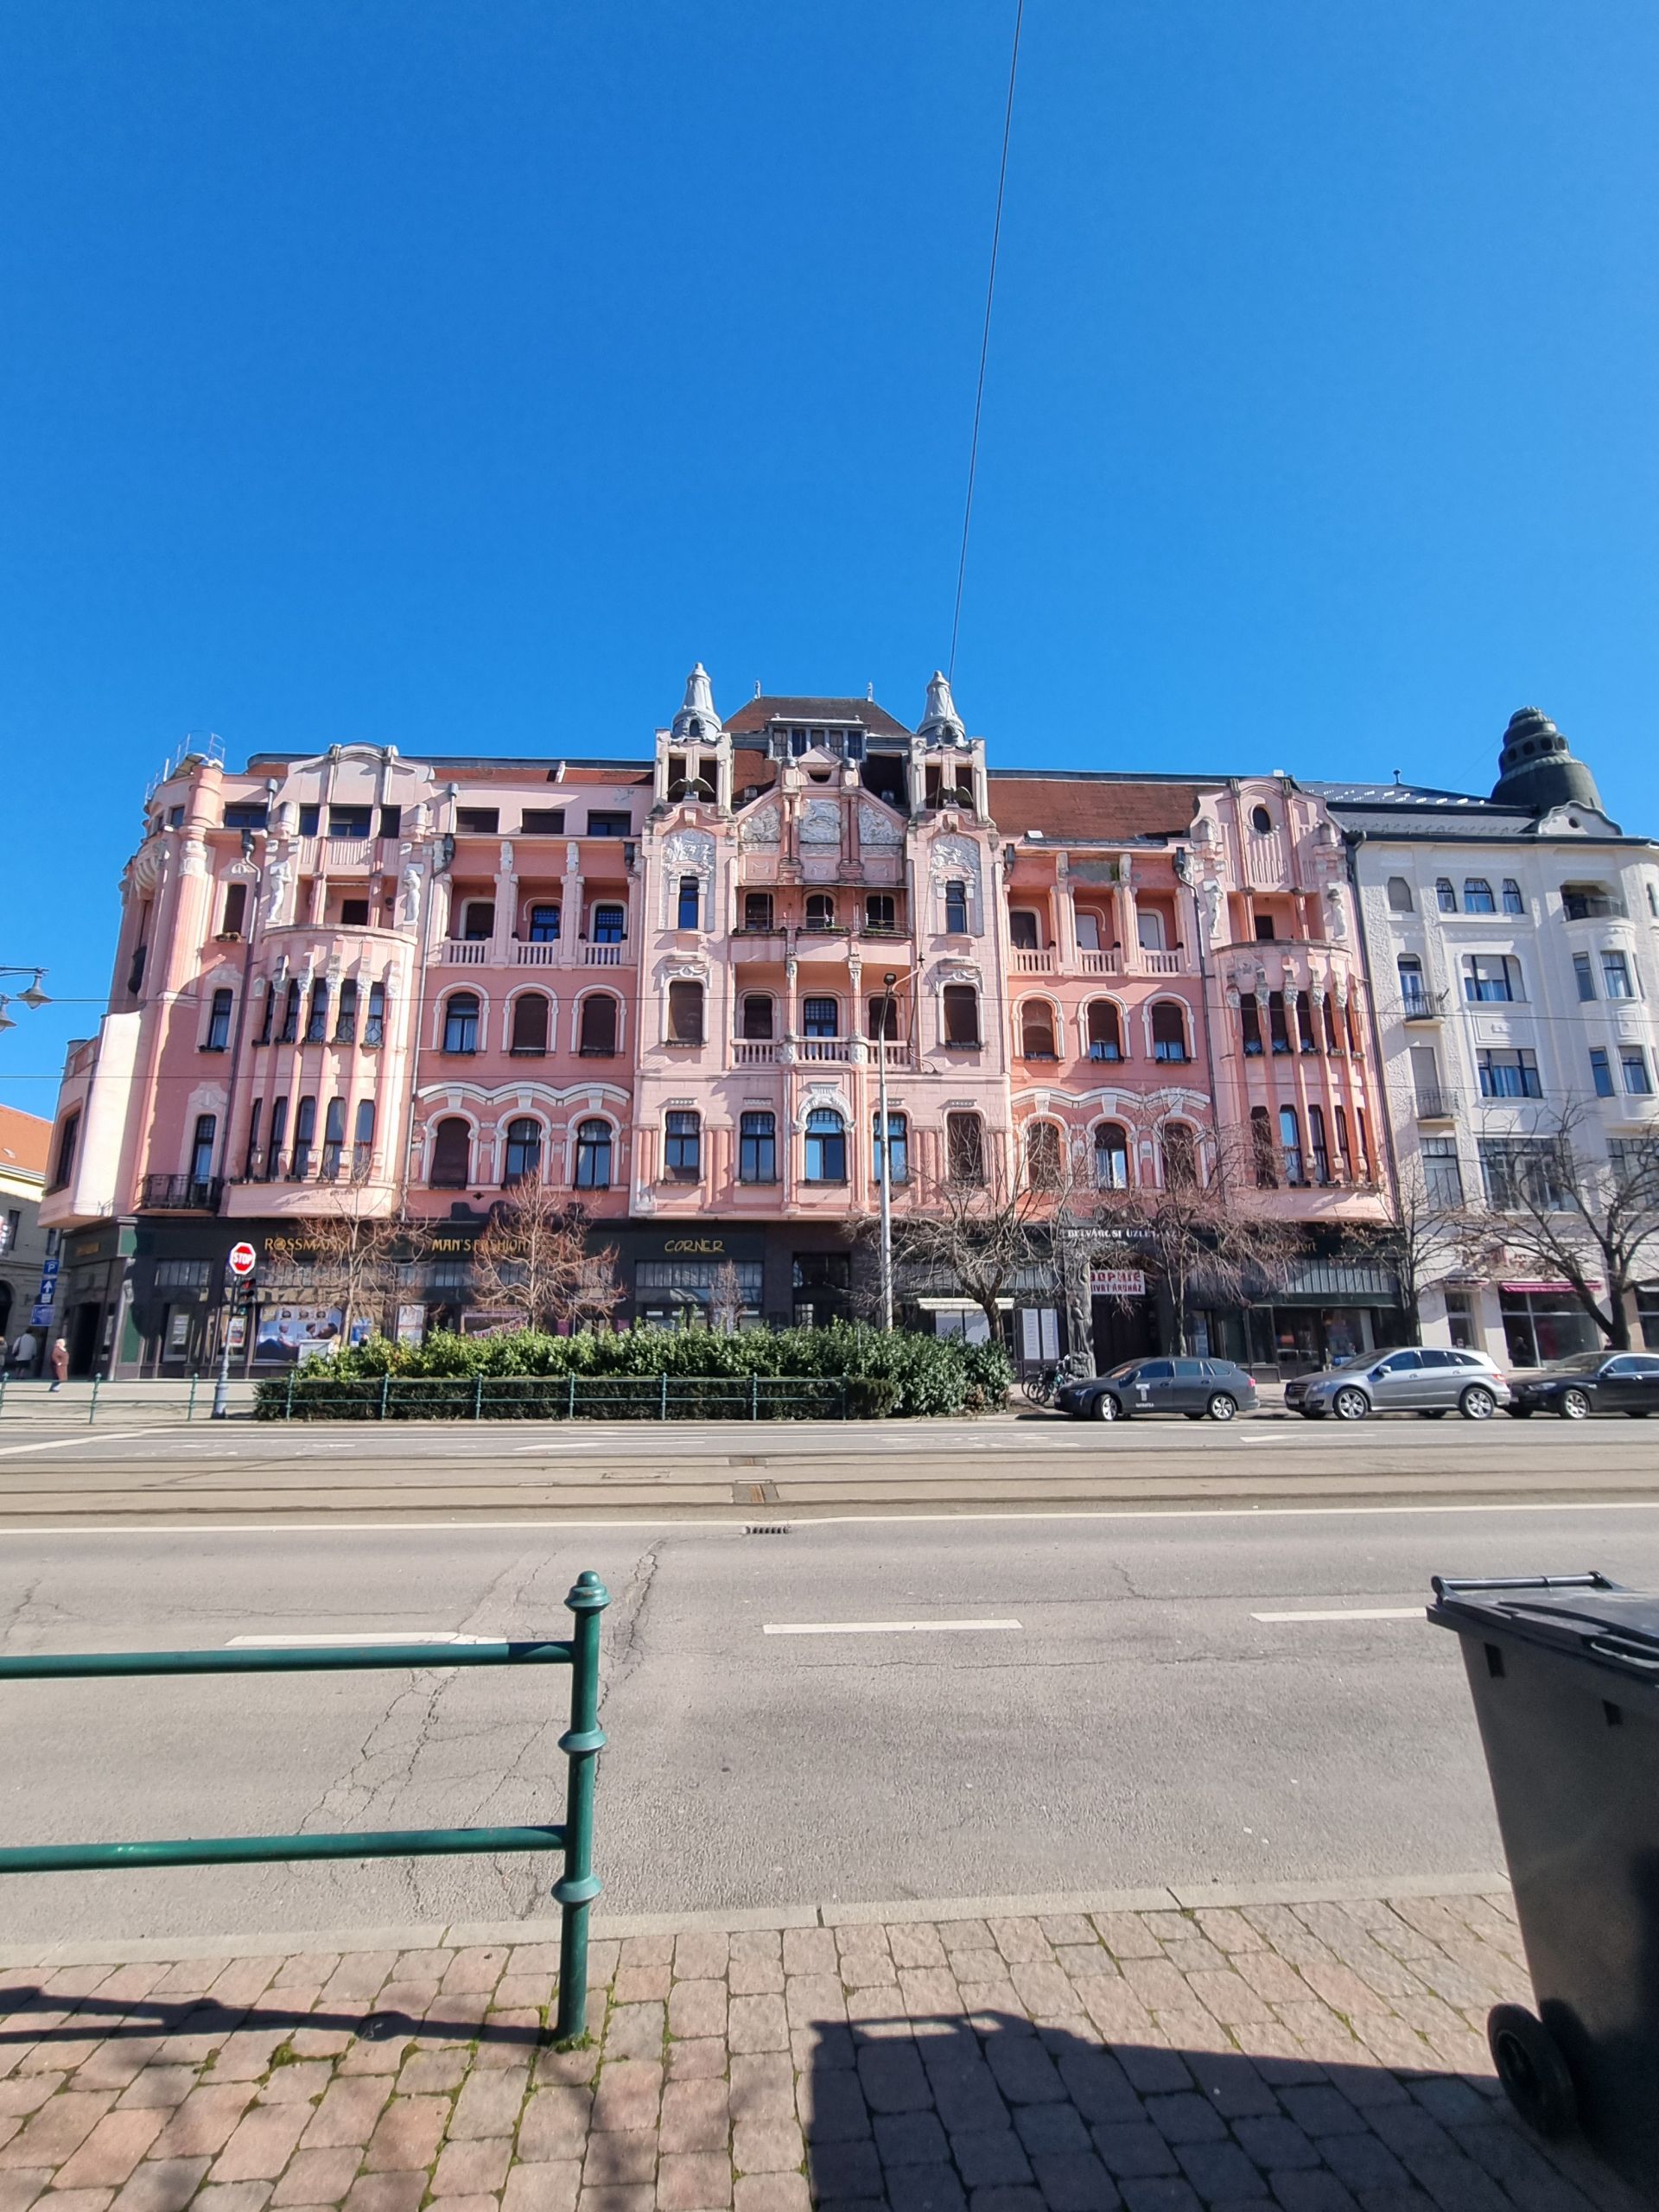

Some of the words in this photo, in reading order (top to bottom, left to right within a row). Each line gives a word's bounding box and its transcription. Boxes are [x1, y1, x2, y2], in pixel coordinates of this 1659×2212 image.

[432, 1238, 471, 1251] MAN'S
[664, 1238, 725, 1252] CORNER
[232, 1252, 253, 1265] STOP
